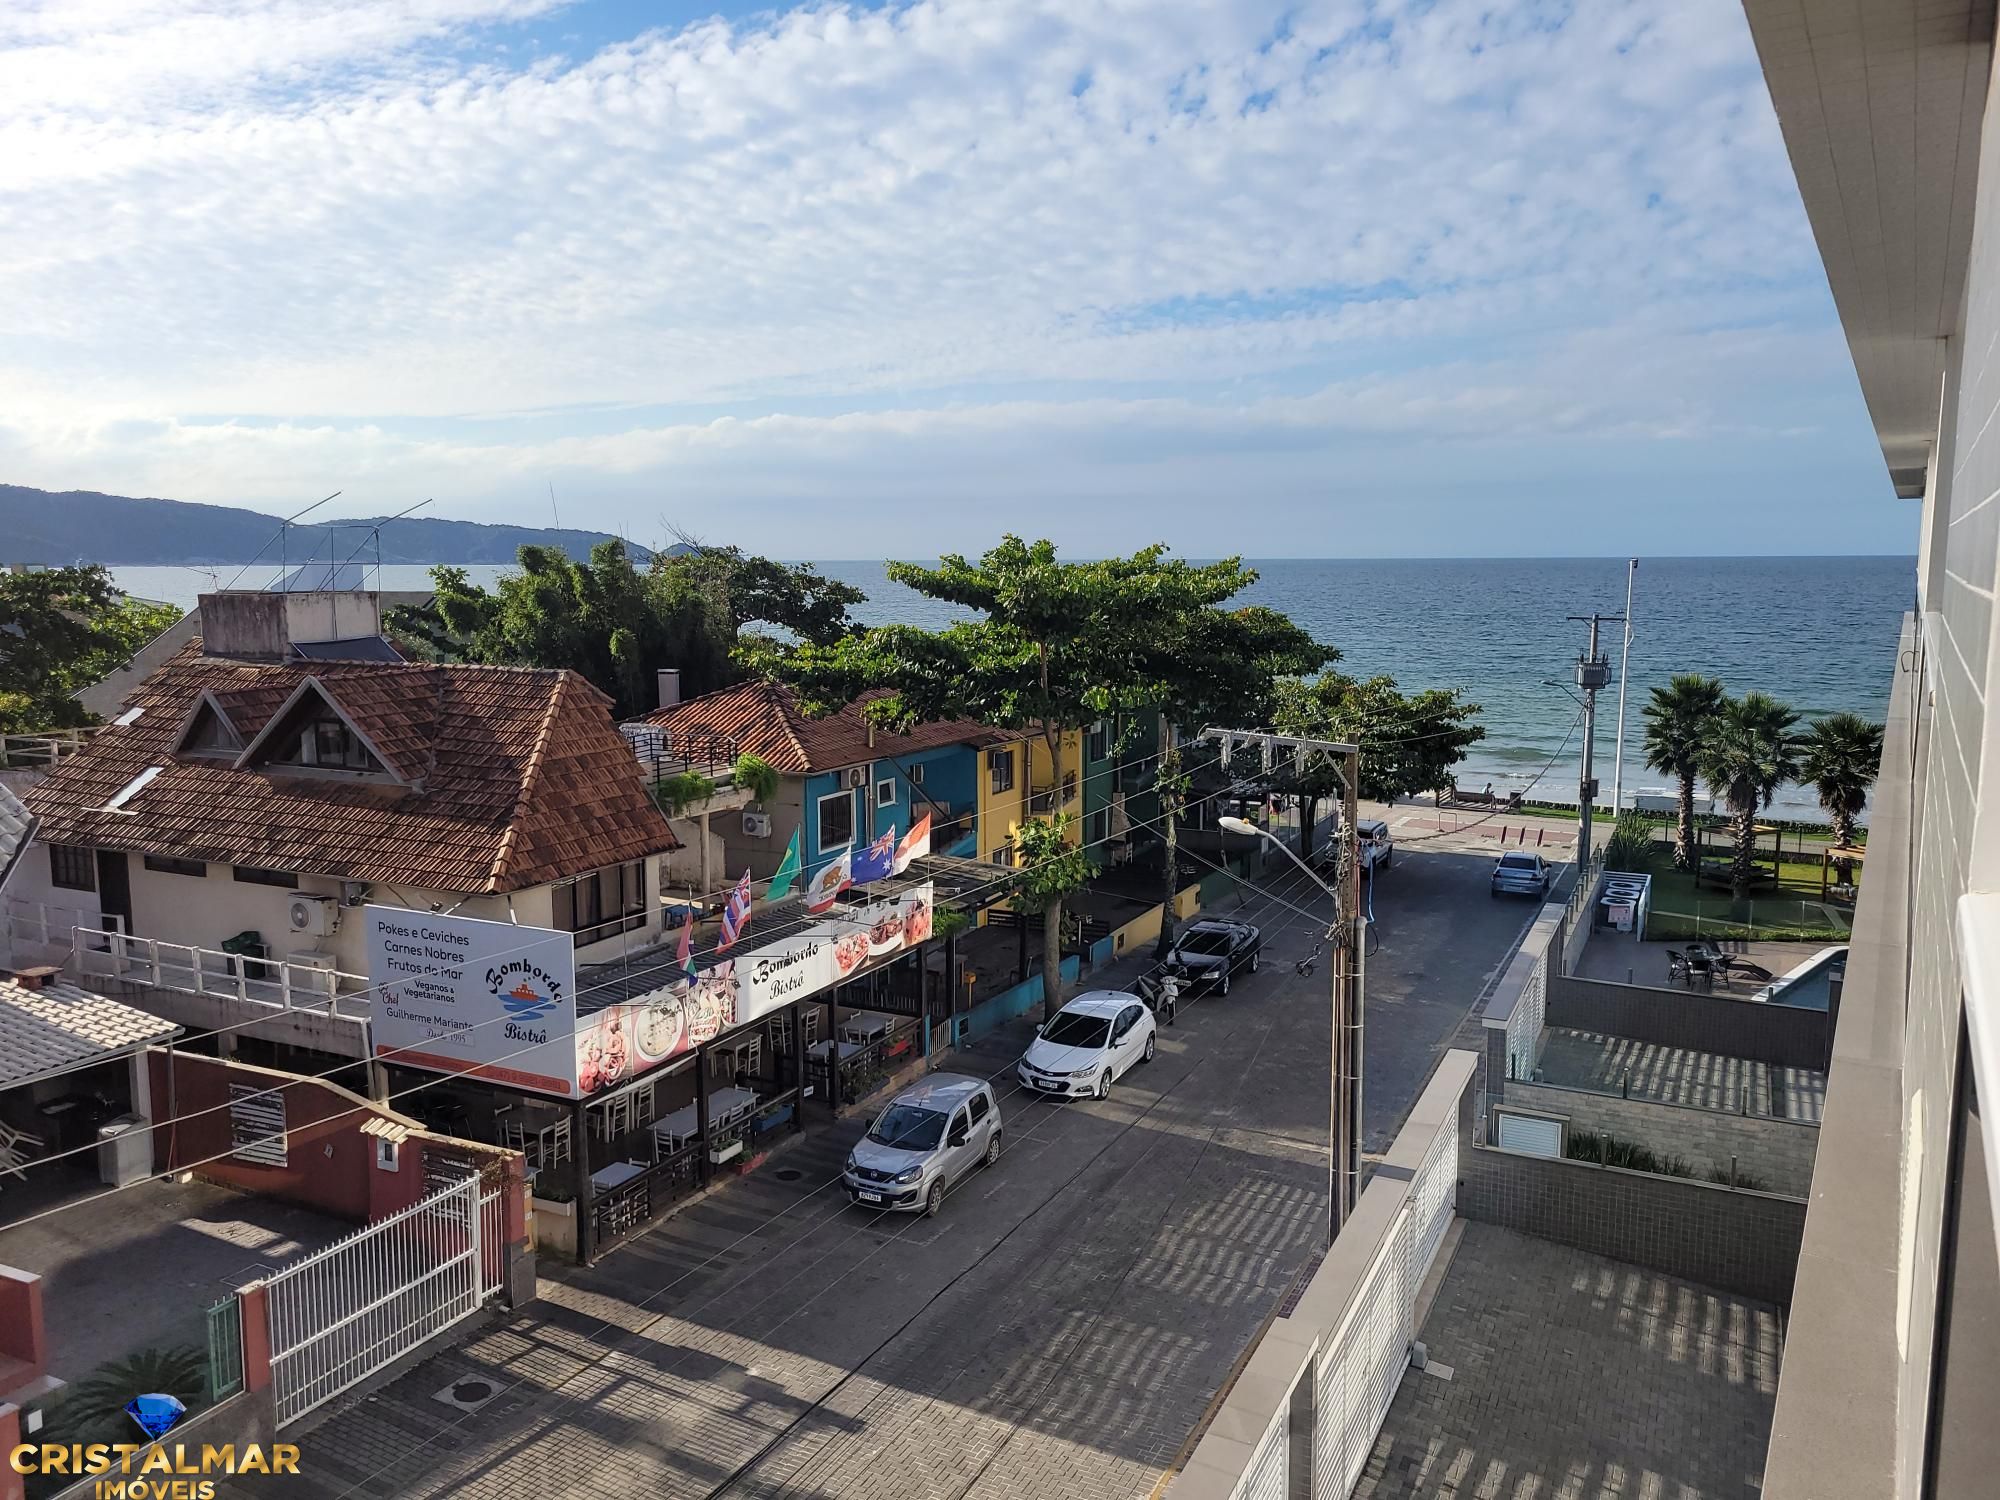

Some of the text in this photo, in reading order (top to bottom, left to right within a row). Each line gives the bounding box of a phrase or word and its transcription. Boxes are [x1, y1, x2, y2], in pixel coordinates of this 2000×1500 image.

[378, 921, 470, 946] Pokes e Ceviches
[384, 939, 465, 963] Carnes Nobres
[387, 957, 422, 974] Frutos
[440, 966, 463, 980] Mar
[751, 941, 819, 985] Bombordo
[414, 979, 448, 993] Veganos
[485, 958, 562, 1003] Bombordo
[769, 970, 805, 1000] Bistrô
[382, 992, 399, 1006] Chef
[403, 987, 455, 1003] Vegetarianos
[386, 1007, 432, 1024] Guilherme
[504, 1022, 548, 1044] Bistrô
